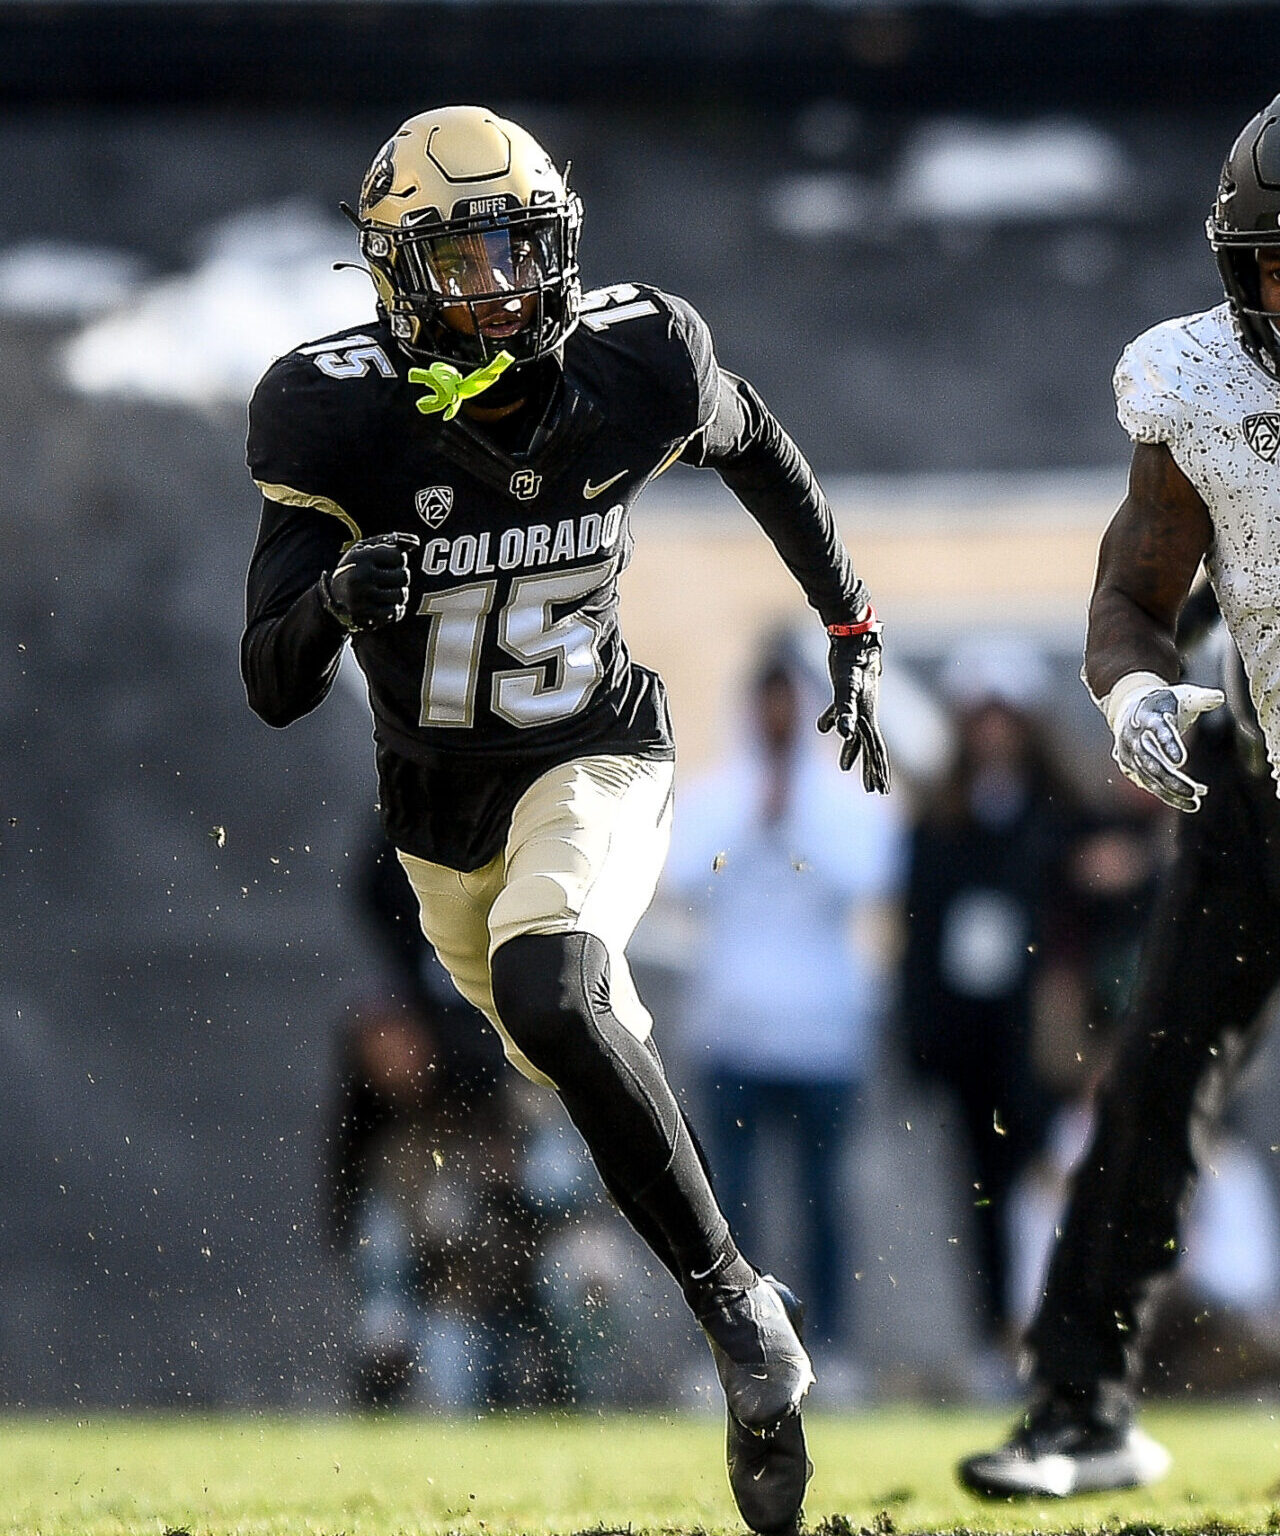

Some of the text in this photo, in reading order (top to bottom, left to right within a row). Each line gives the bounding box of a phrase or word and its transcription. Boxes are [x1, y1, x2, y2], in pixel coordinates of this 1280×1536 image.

[469, 197, 507, 216] BUFFS
[295, 334, 398, 380] 15
[1245, 415, 1280, 444] PAC
[1255, 434, 1275, 452] 12
[418, 488, 452, 513] PAC
[425, 504, 445, 520] 12
[421, 504, 624, 576] COLORADO
[416, 552, 621, 729] 15
